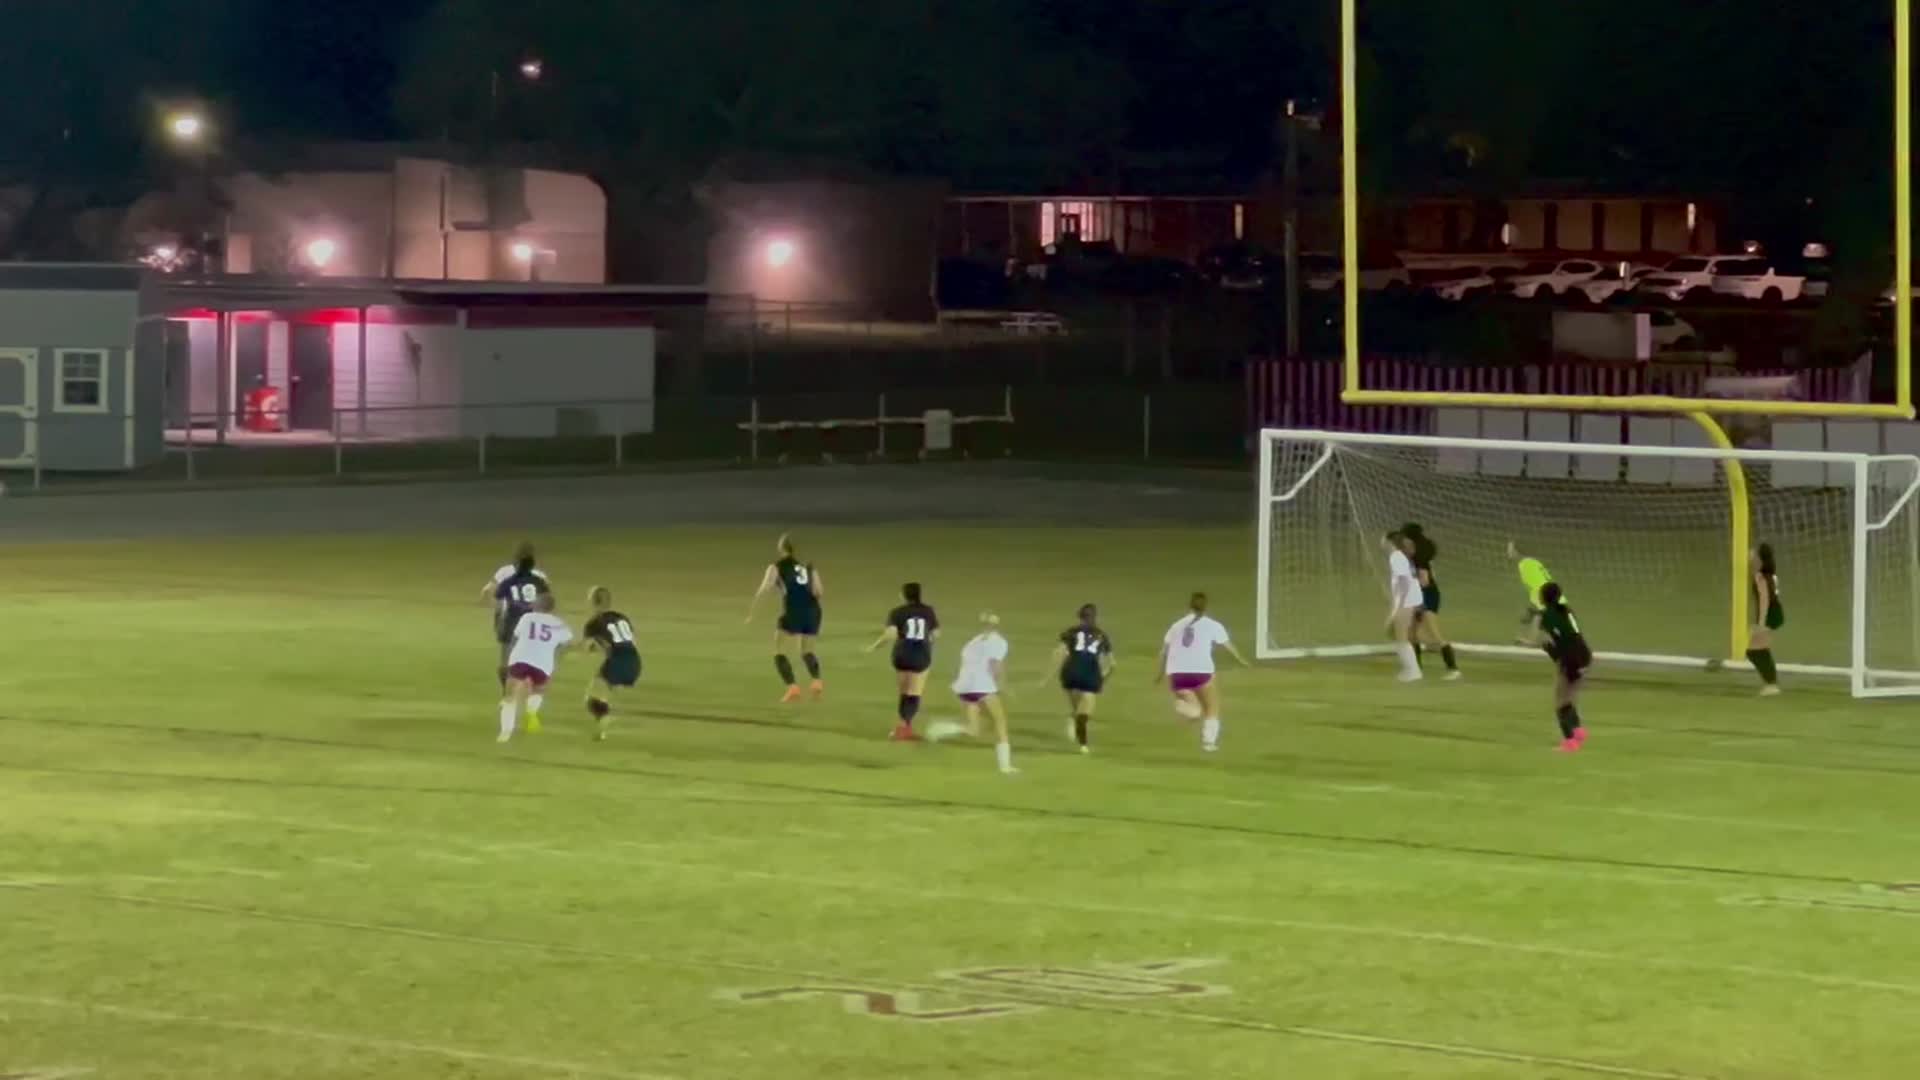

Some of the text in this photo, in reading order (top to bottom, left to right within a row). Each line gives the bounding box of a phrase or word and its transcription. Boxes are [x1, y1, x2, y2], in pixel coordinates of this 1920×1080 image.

[794, 564, 809, 585] 3
[527, 622, 552, 642] 15
[606, 619, 633, 643] 10
[905, 617, 926, 640] 11
